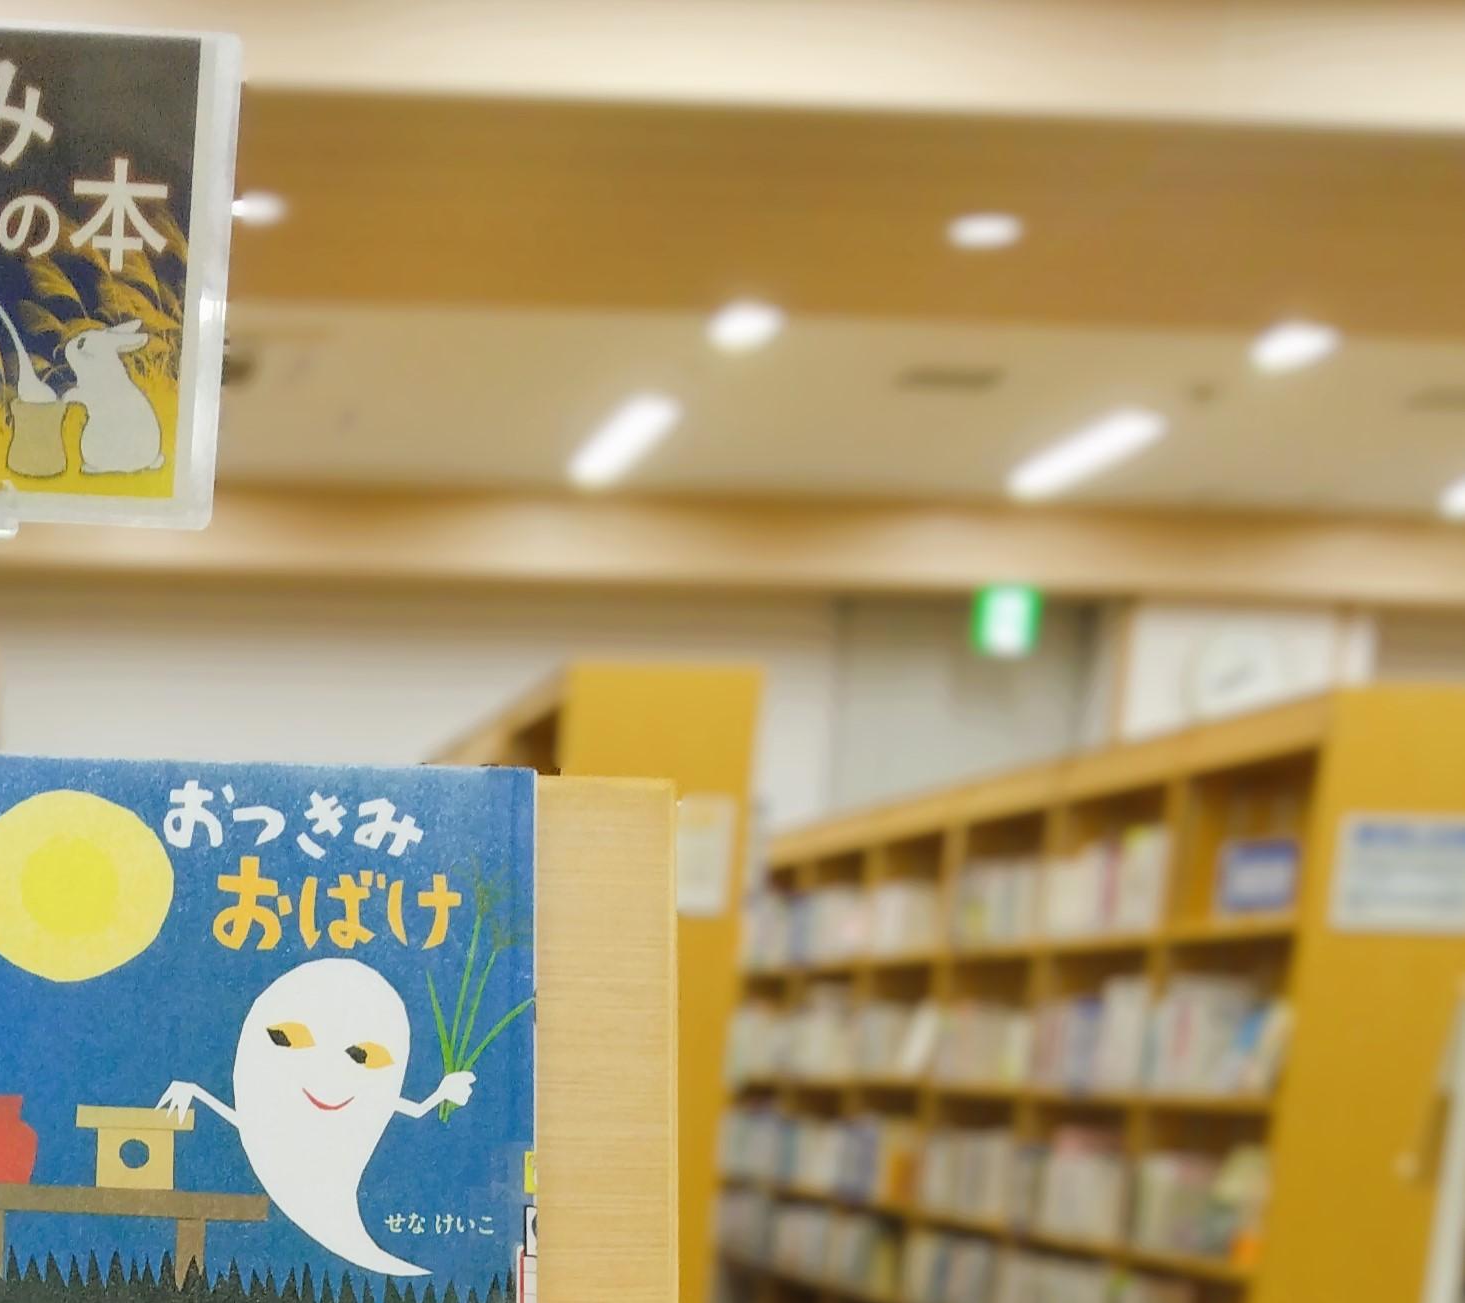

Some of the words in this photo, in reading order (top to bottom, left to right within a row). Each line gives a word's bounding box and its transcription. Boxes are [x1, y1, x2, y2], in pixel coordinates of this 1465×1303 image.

[162, 779, 424, 858] おつきみ
[212, 855, 462, 950] おばけ
[384, 1211, 427, 1236] せな
[434, 1212, 495, 1236] けいこ
